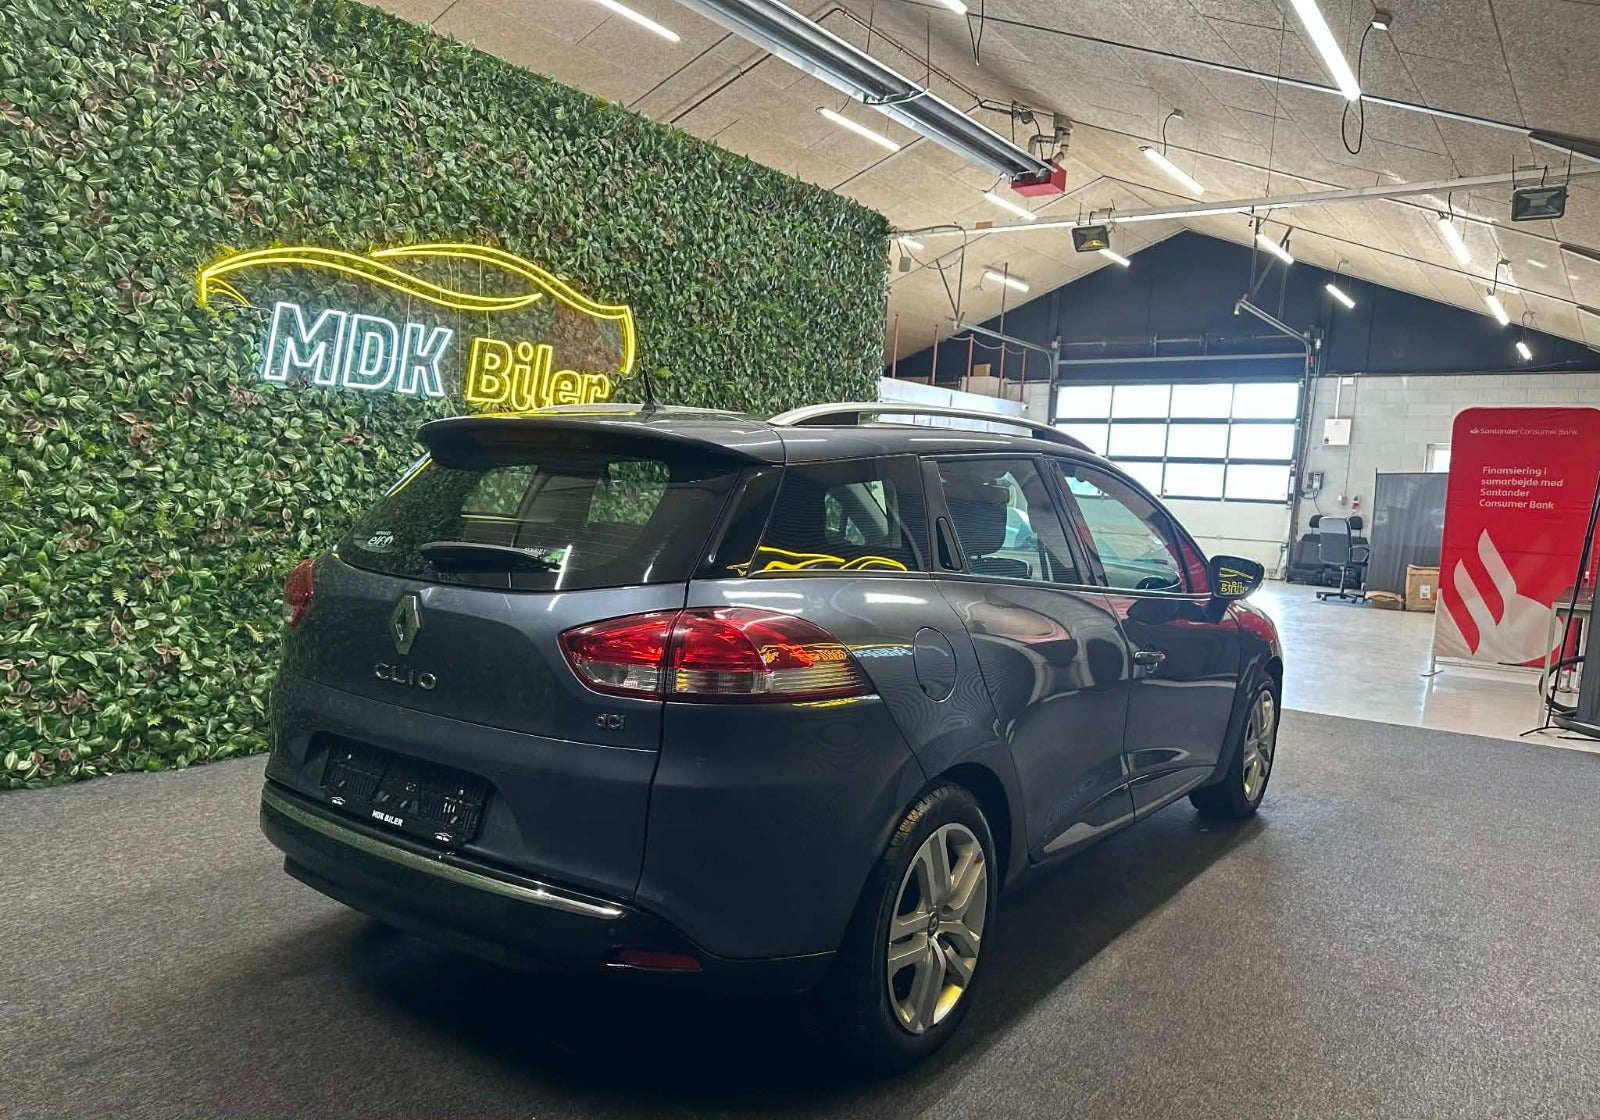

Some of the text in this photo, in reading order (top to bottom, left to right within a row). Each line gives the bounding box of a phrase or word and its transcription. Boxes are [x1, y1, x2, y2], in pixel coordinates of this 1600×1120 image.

[263, 301, 610, 410] MDK Biler
[1480, 427, 1578, 436] Santander Consumer Bank
[1482, 466, 1542, 477] Finansiering
[1480, 478, 1564, 488] samarbejde med
[1479, 488, 1530, 498] Santander
[1479, 498, 1555, 510] Consumer Bank
[374, 662, 437, 690] CLIO
[384, 814, 404, 827] BILER
